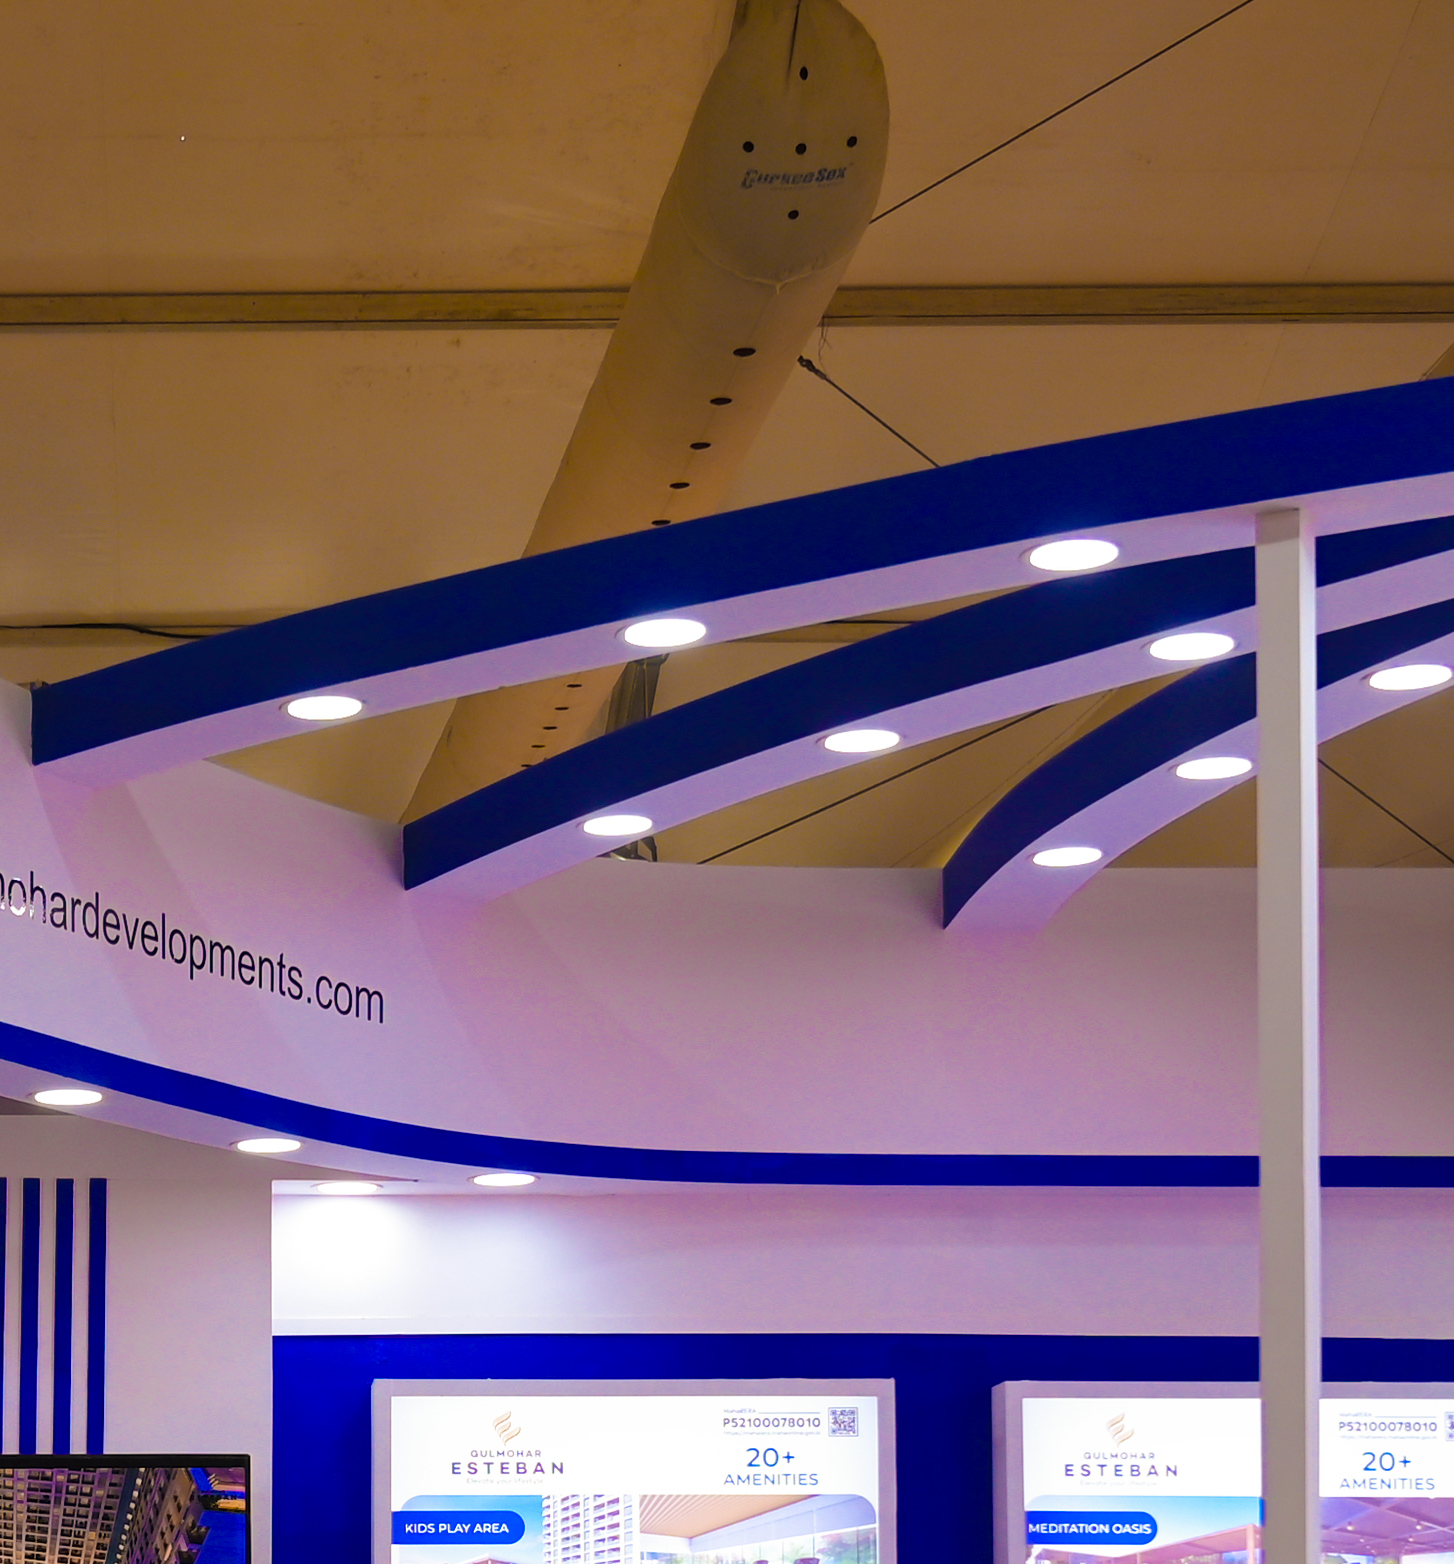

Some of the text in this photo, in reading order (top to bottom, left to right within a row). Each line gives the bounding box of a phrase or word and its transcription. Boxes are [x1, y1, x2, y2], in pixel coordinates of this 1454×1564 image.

[723, 1418, 821, 1427] P52100078010
[1338, 1421, 1437, 1431] P52100078010
[747, 1448, 794, 1467] 20+
[1363, 1452, 1411, 1471] 20+
[452, 1462, 563, 1474] ESTEBAN
[1065, 1464, 1177, 1476] ESTEBAN
[724, 1474, 818, 1485] AMENITIES
[1341, 1478, 1435, 1490] AMENITIES
[406, 1523, 509, 1533] KIDS PLAY AREA
[1028, 1523, 1152, 1534] MEDITATION OASIS
